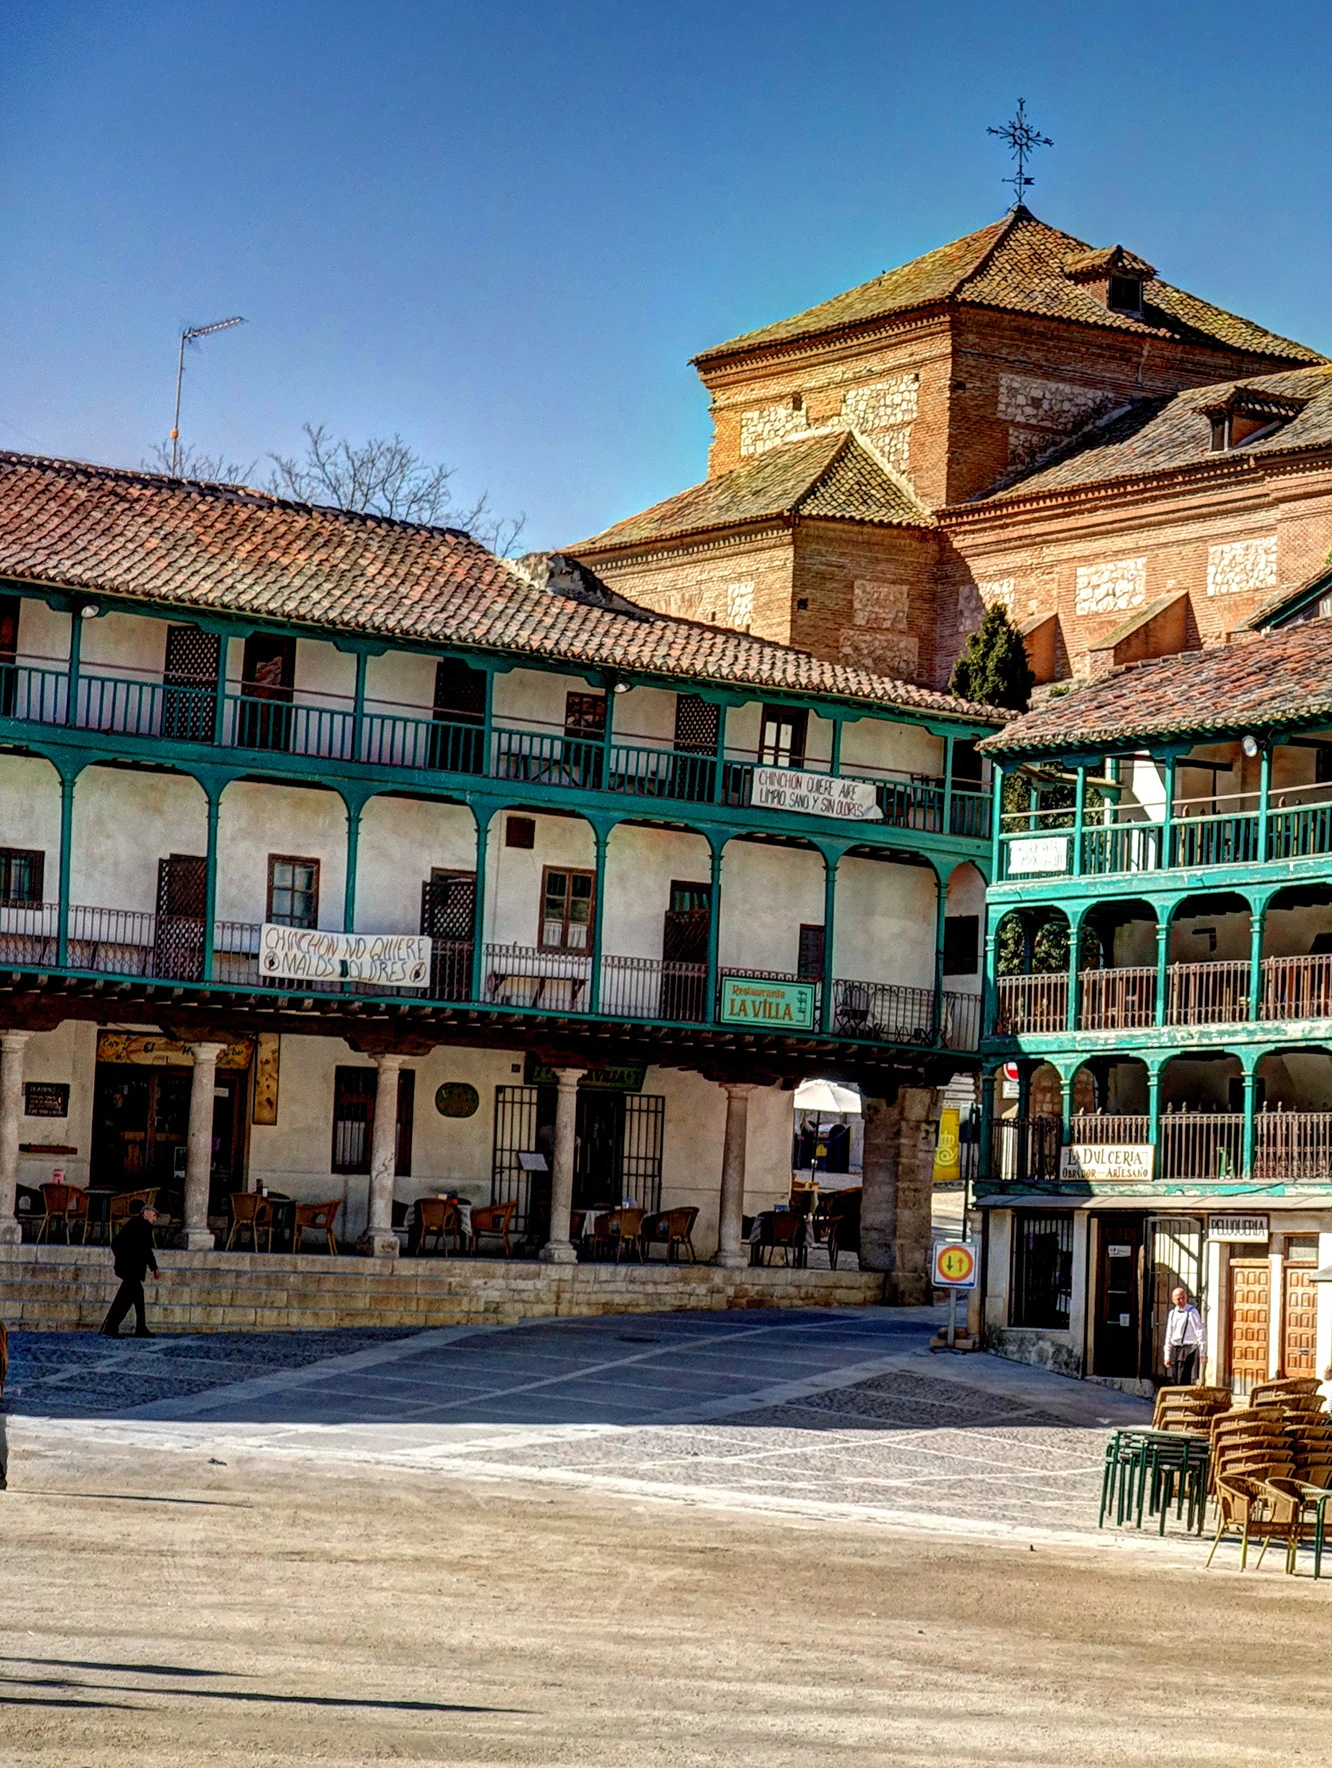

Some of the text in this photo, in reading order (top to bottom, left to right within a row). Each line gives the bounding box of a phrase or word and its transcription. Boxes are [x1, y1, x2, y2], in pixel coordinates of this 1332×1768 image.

[807, 776, 834, 796] QUIERE
[839, 783, 859, 800] AIRE
[789, 792, 810, 810] SANO
[812, 795, 820, 810] Y
[820, 797, 836, 815] SIN
[344, 937, 366, 960] NO
[370, 937, 425, 961] QUIERE
[281, 952, 335, 977] MALOS
[732, 985, 786, 999] Restaurante
[729, 998, 748, 1017] LA
[1067, 1148, 1080, 1166] LA
